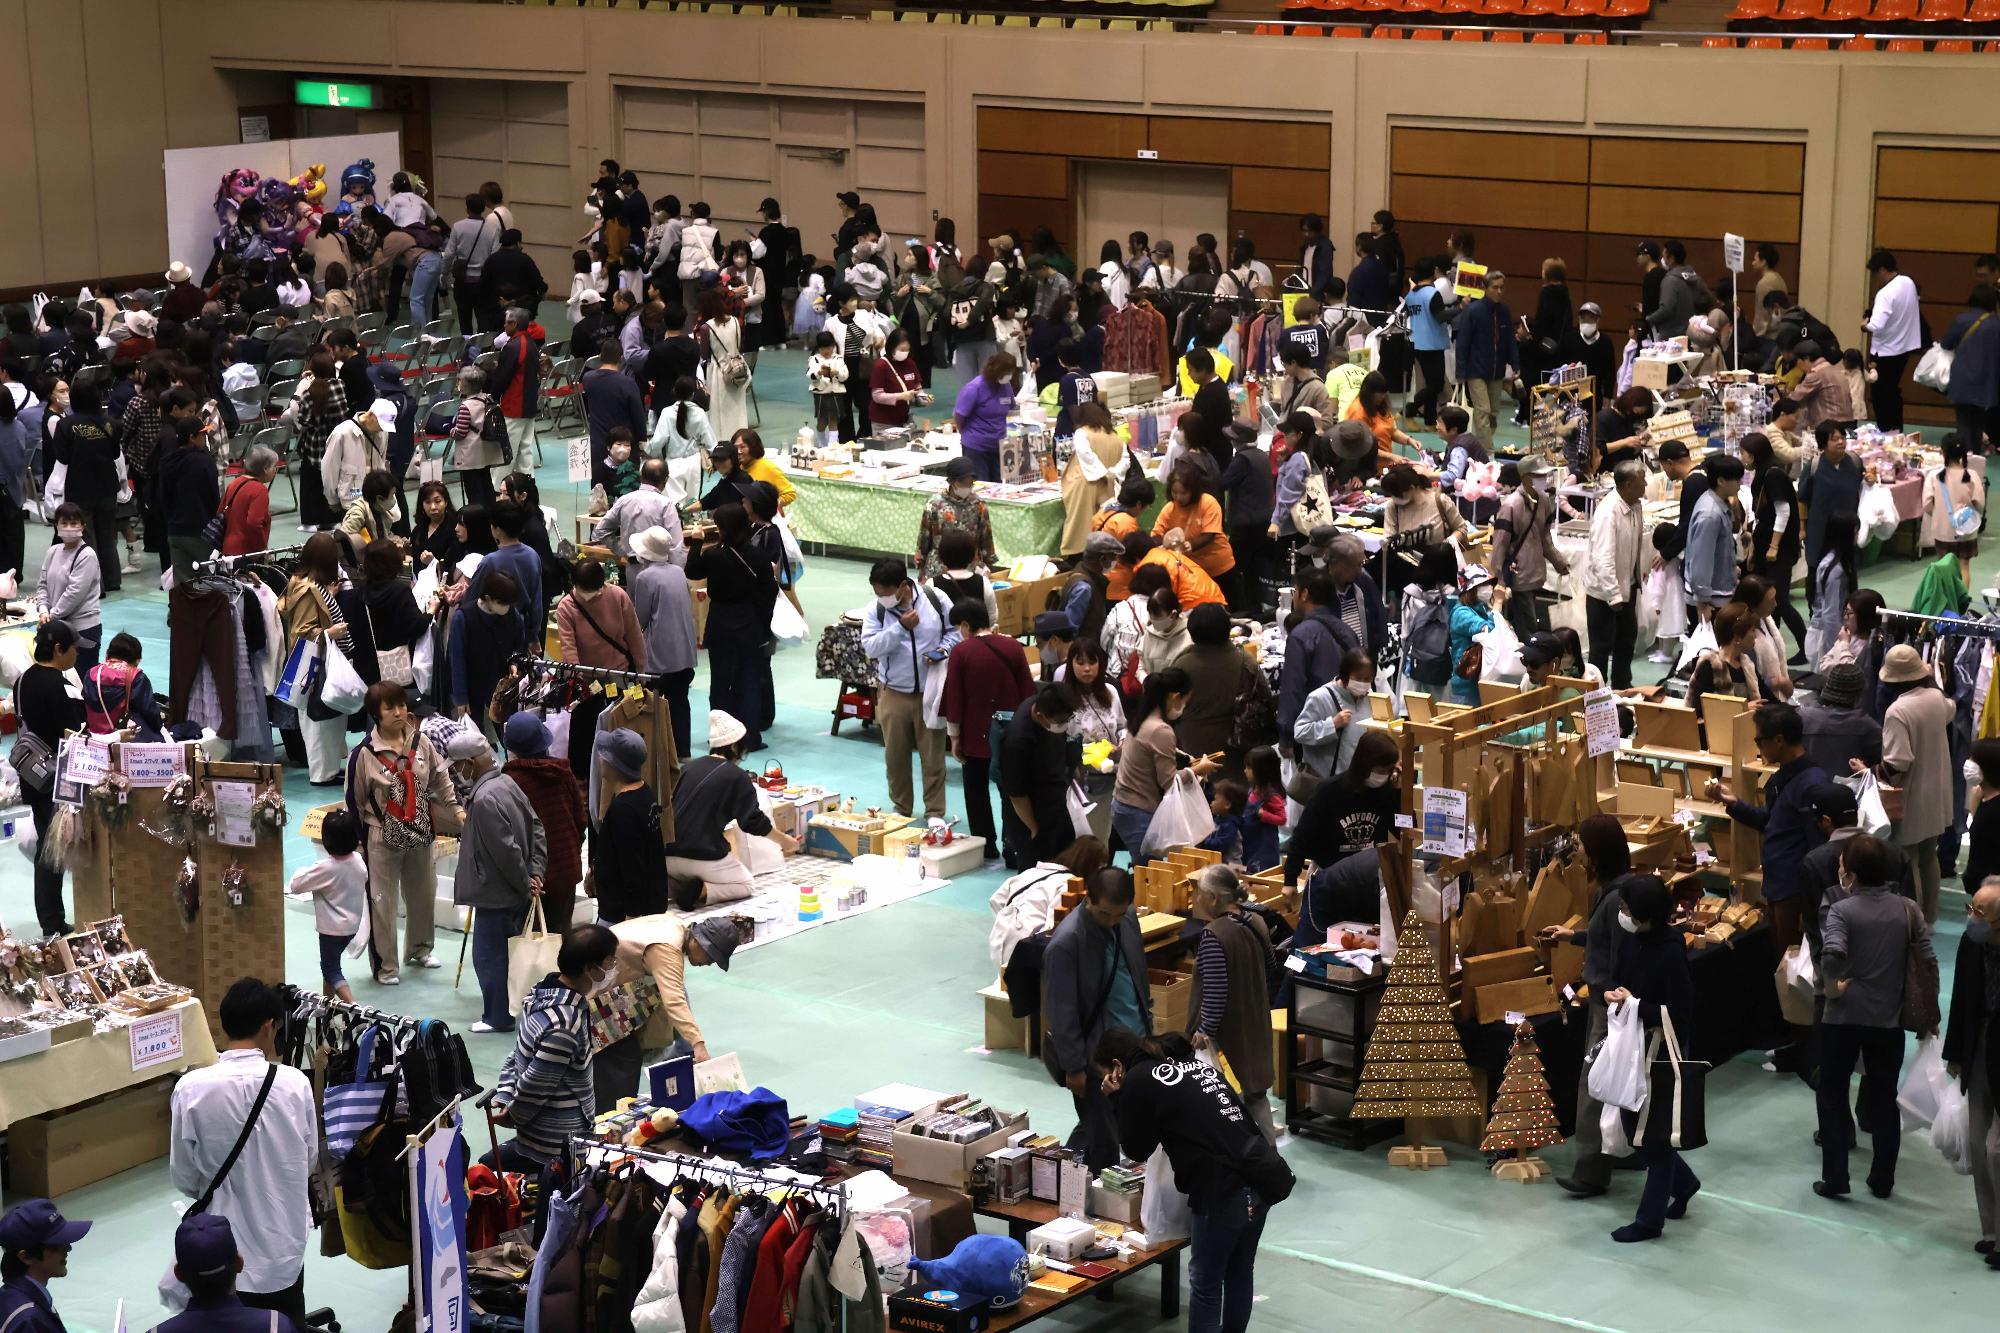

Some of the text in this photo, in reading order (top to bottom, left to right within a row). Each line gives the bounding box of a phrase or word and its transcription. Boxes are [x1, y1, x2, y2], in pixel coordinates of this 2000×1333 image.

[580, 438, 589, 478] ワイヤー
[1340, 812, 1380, 829] BABYDOLL
[900, 1316, 945, 1333] AVIREX
